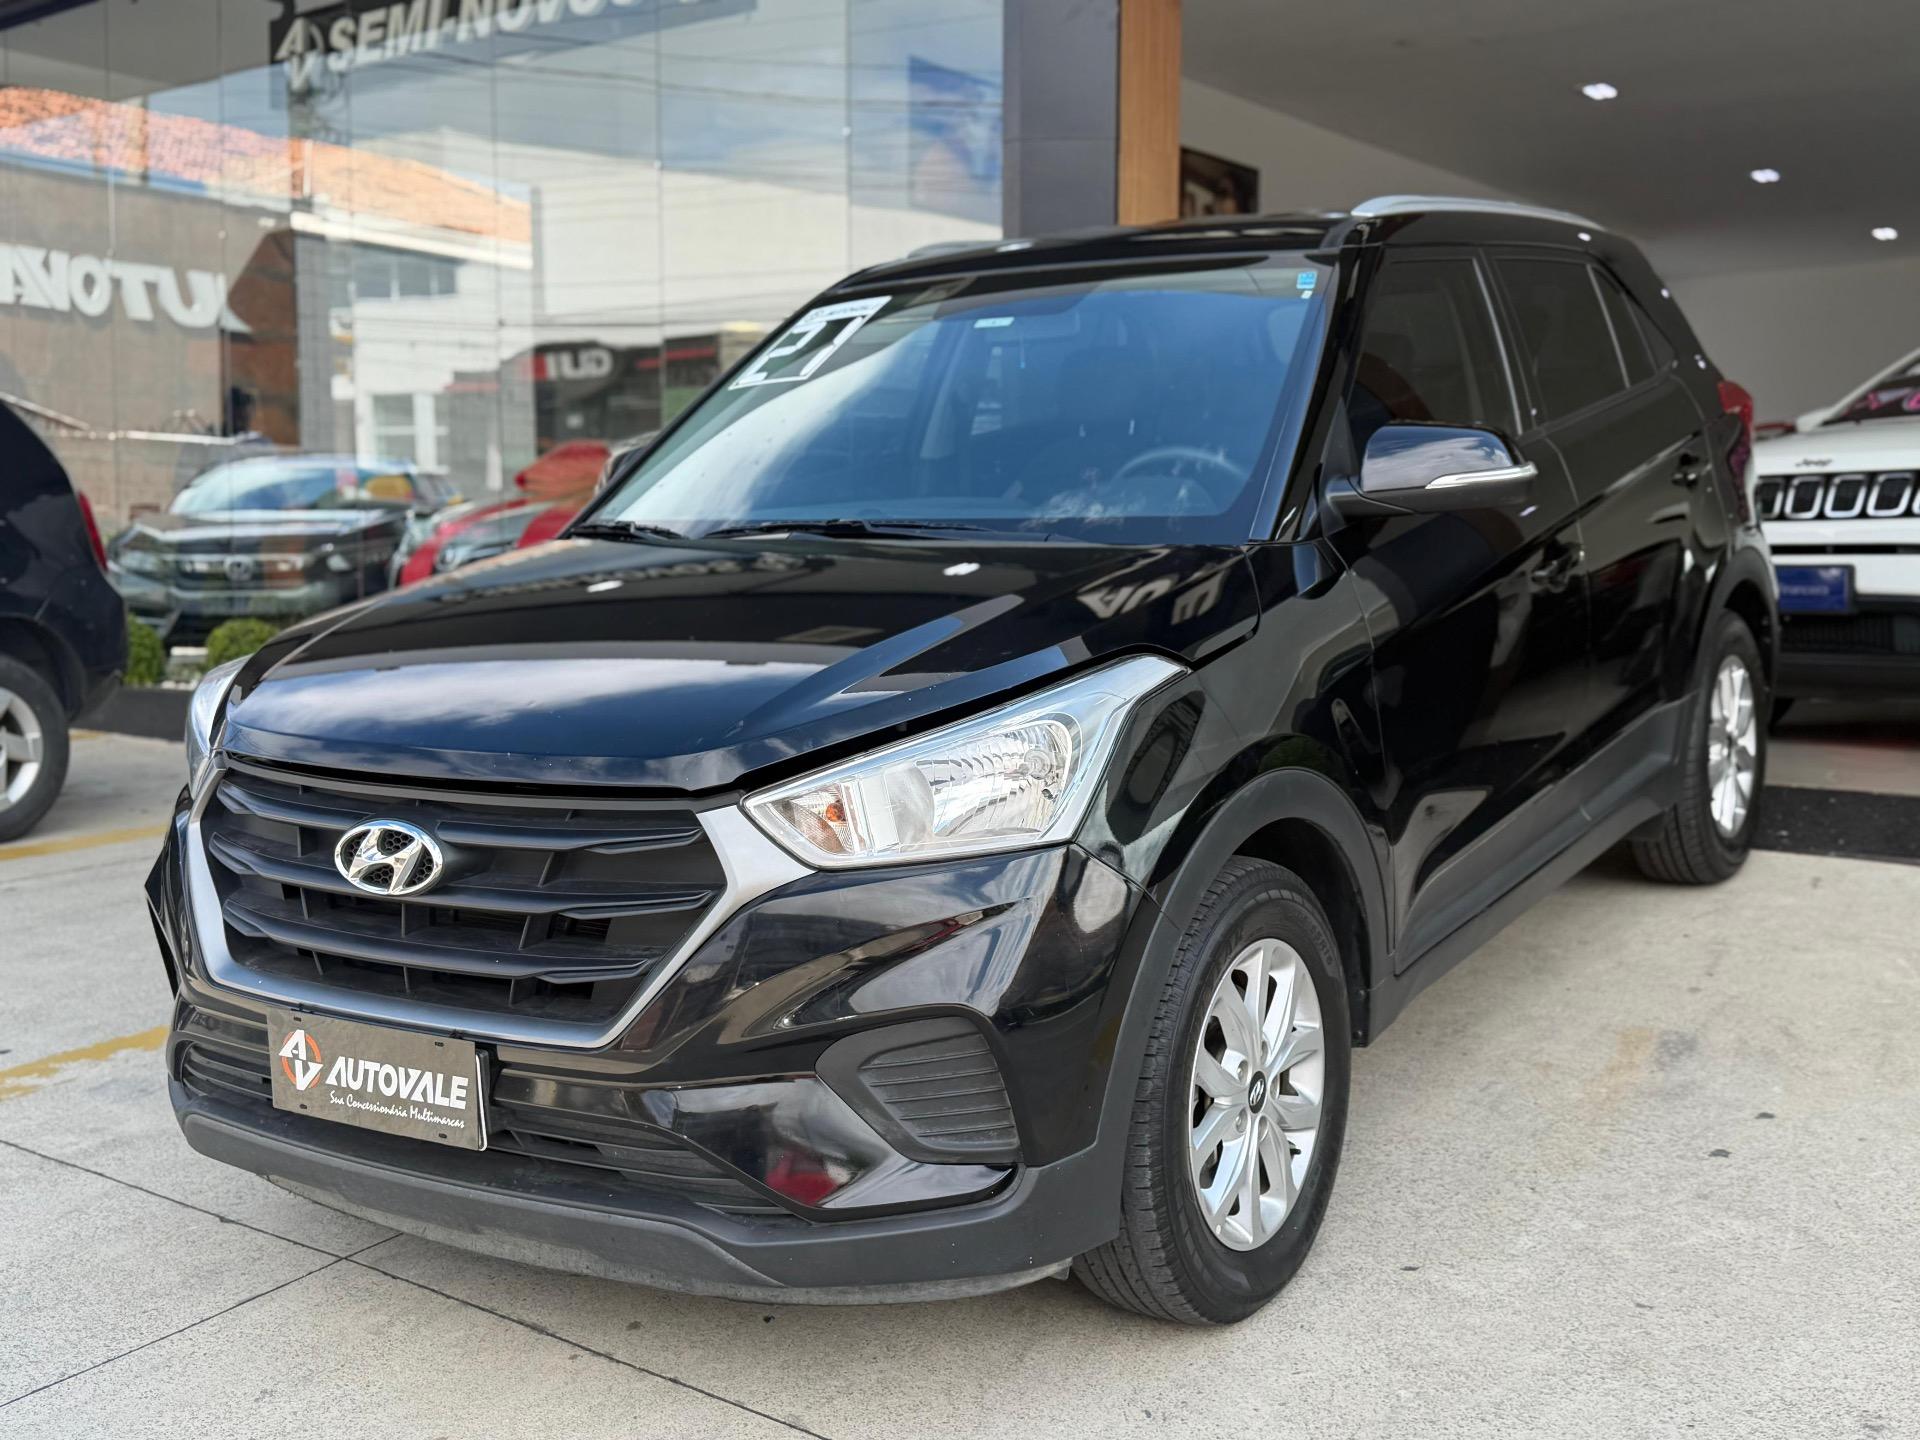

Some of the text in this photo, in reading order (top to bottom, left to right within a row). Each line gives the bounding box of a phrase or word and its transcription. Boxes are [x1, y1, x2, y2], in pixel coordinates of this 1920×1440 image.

[326, 1056, 468, 1109] AUTOVALE
[329, 1089, 465, 1129] Sua Concessionária Multimarcas
